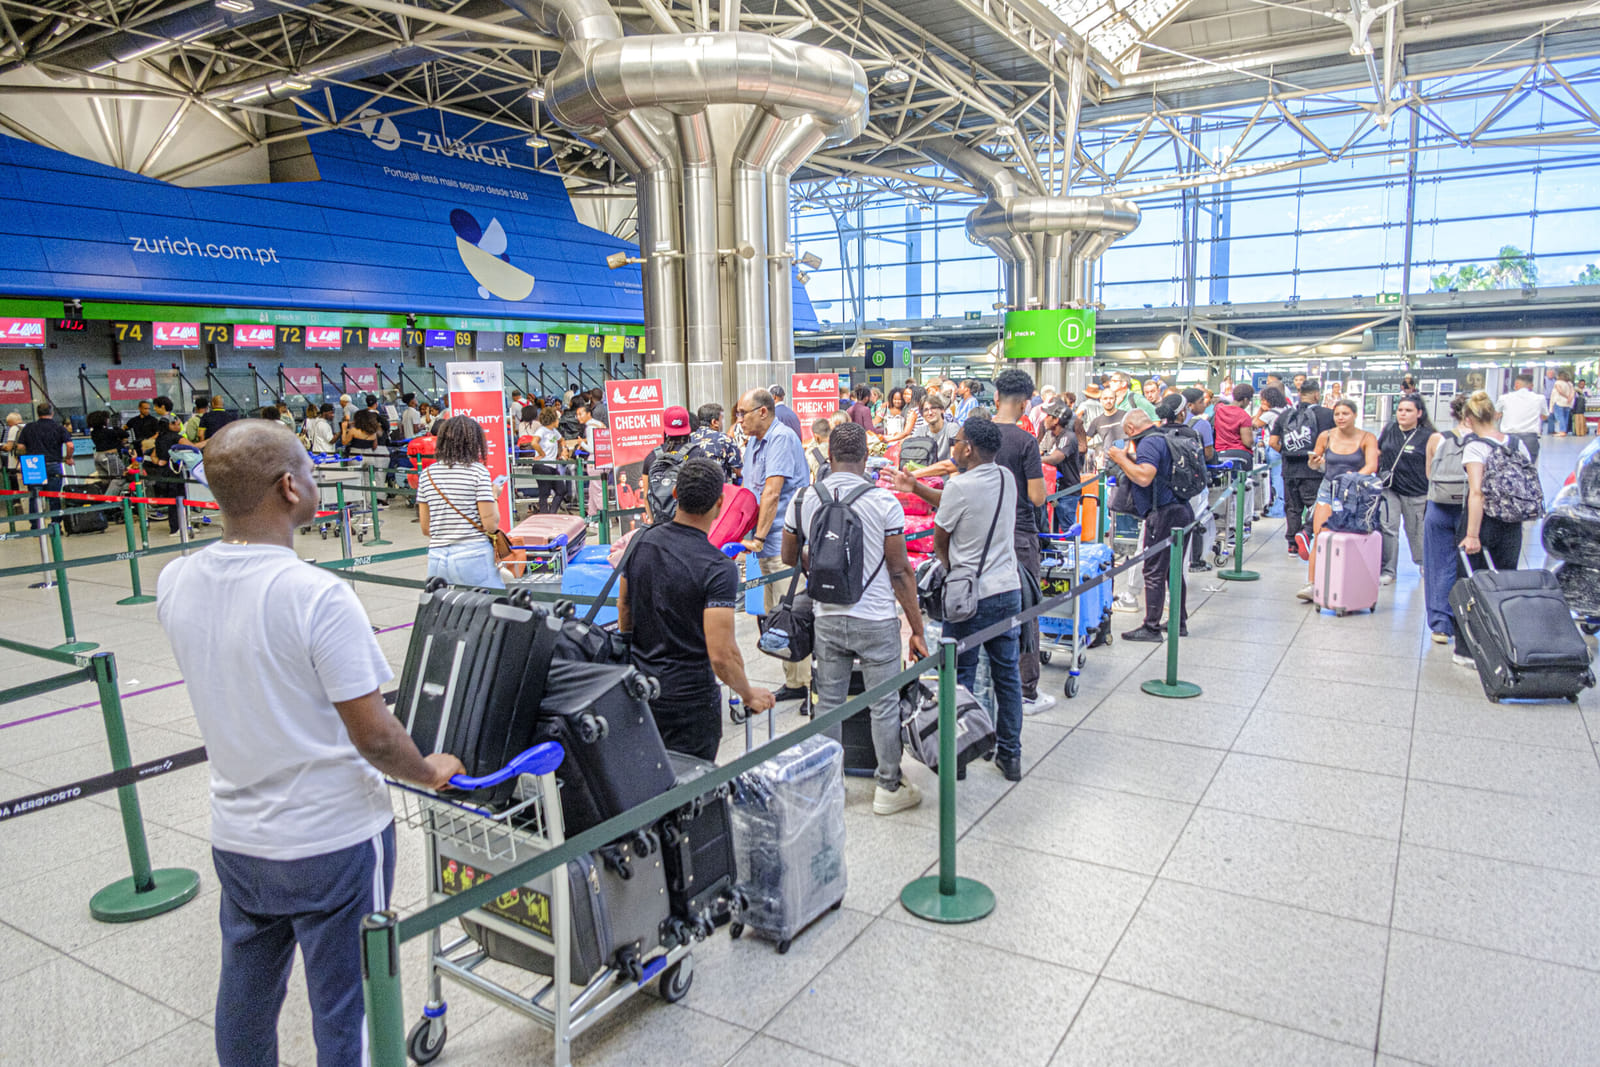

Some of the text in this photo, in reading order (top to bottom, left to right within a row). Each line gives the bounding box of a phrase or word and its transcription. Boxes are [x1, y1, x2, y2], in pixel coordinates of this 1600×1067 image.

[417, 131, 511, 169] ZURICH
[383, 166, 529, 201] Portugal está mais seguro desde 1918
[129, 235, 280, 266] zurich.com.pt
[115, 323, 143, 342] 74
[204, 326, 228, 342] 73
[280, 327, 301, 343] 72
[344, 329, 363, 344] 71
[406, 330, 423, 345] 70
[456, 332, 471, 346] 69
[1067, 323, 1080, 342] D
[506, 334, 521, 347] 68
[548, 335, 560, 348] 67
[590, 336, 601, 348] 66
[624, 337, 636, 349] 65
[876, 353, 883, 363] D
[453, 408, 472, 417] SKY
[797, 401, 835, 414] CHECK-IN
[473, 415, 501, 424] ORITY
[615, 414, 661, 430] CHECK-IN
[13, 787, 81, 814] AEROPORTO
